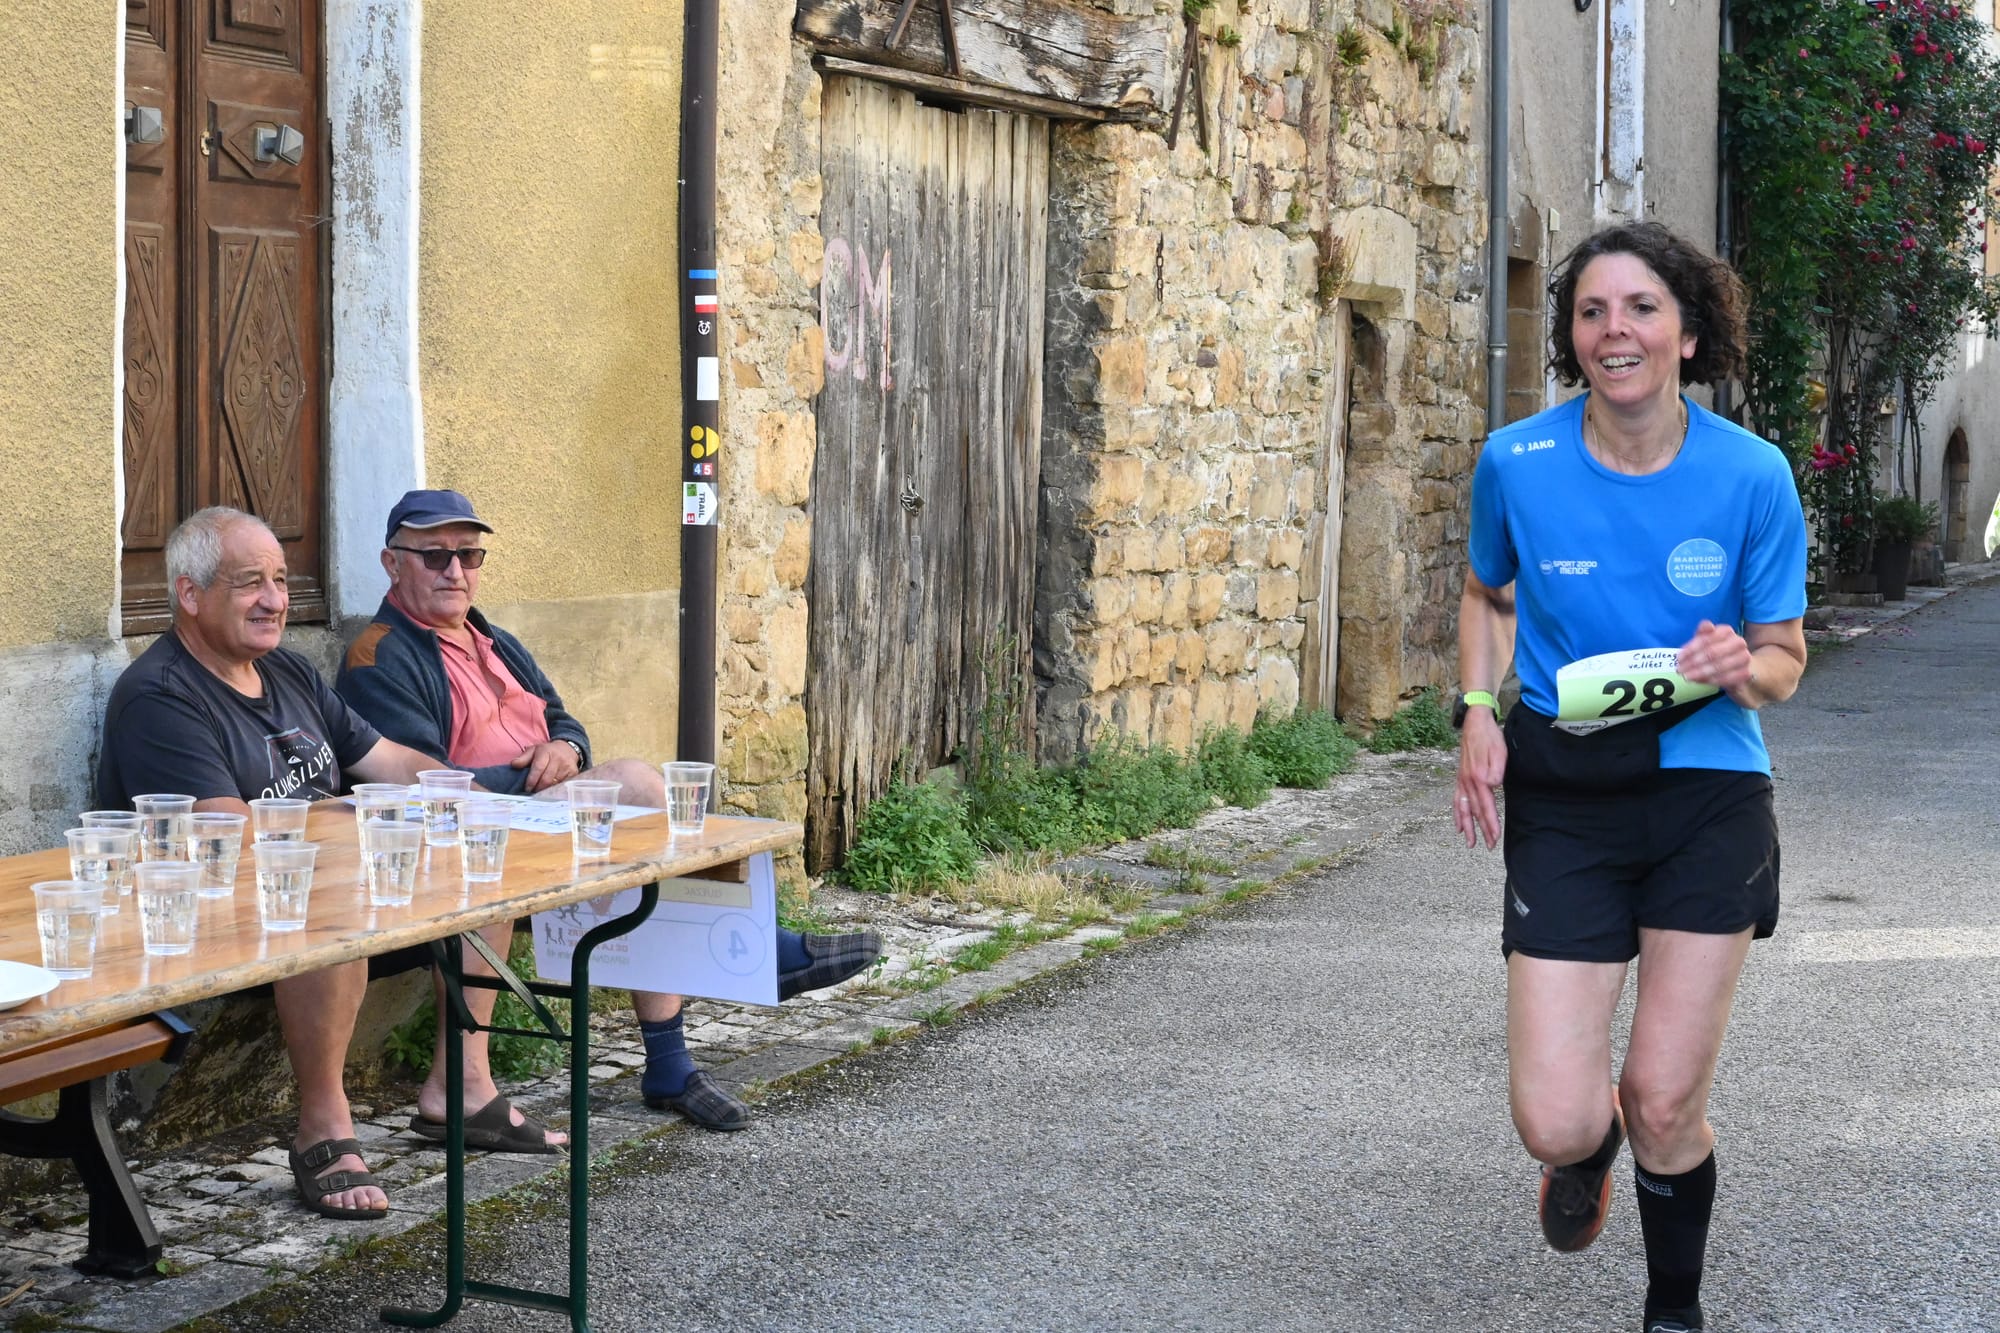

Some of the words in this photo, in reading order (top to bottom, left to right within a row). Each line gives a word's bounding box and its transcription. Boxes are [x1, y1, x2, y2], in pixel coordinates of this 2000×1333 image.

[1527, 439, 1555, 452] JAKO
[694, 463, 702, 475] 4
[703, 464, 712, 475] 5
[698, 492, 706, 518] TRAIL
[1633, 652, 1679, 661] Challeng
[1599, 678, 1675, 718] 28
